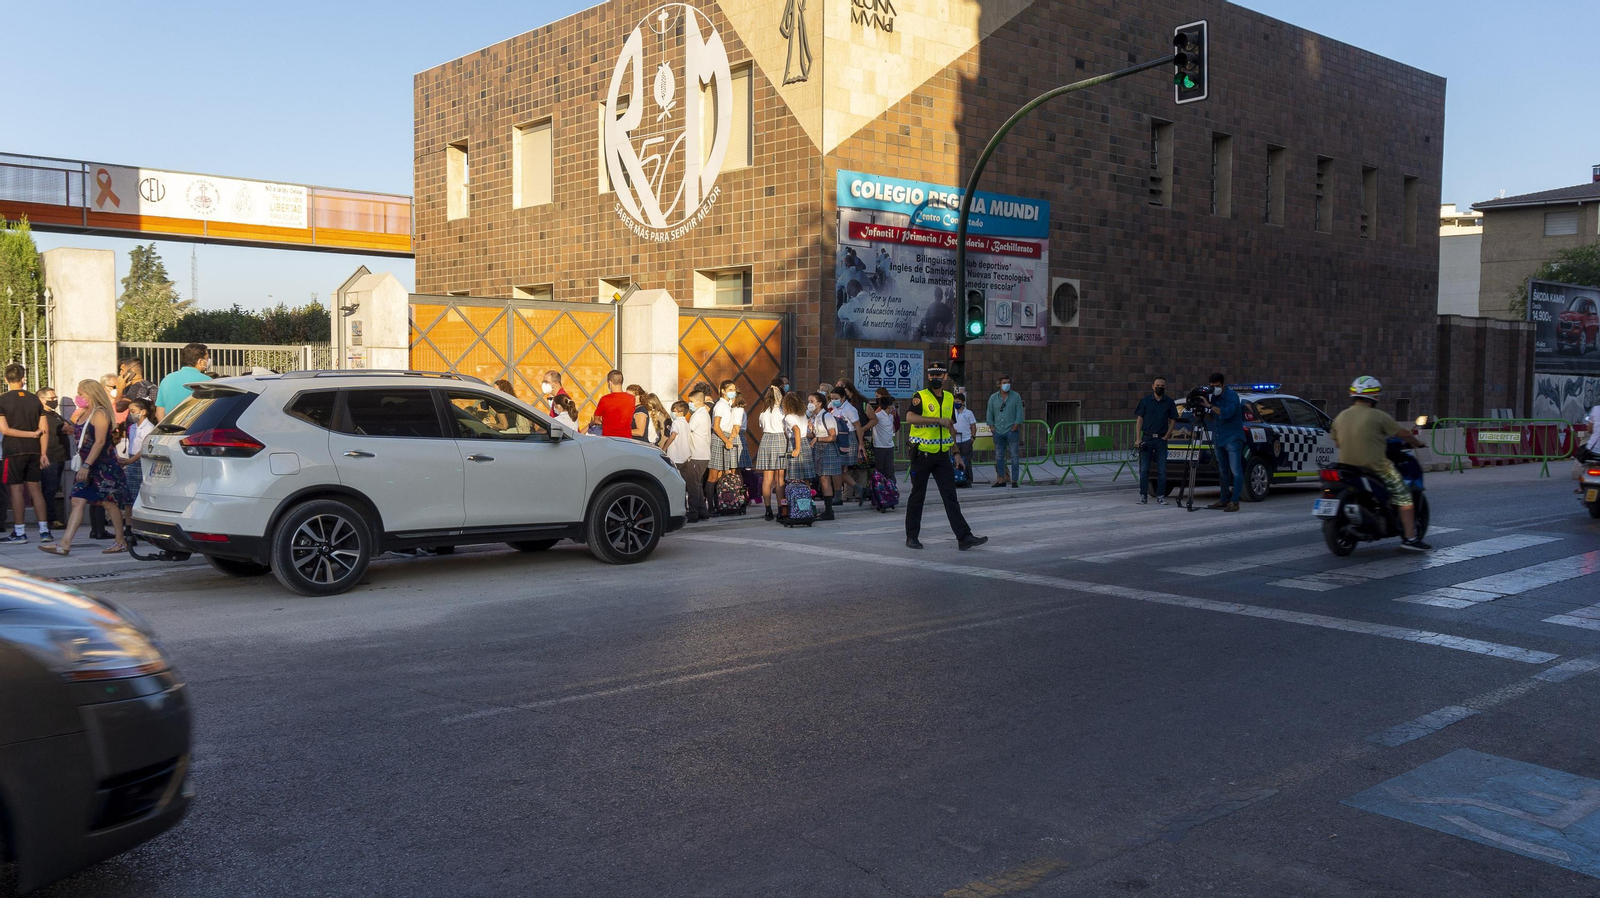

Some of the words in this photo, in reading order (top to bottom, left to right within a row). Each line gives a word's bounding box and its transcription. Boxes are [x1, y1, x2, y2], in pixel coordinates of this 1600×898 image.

[270, 203, 302, 214] LIBERTAD
[851, 180, 924, 205] COLEGIO
[990, 200, 1039, 221] MUNDI
[614, 202, 634, 231] SABER
[633, 226, 649, 240] MÁS
[650, 231, 669, 242] PARA
[671, 217, 698, 240] SERVIR
[697, 185, 722, 223] MEJOR
[914, 211, 941, 223] Centro
[943, 214, 984, 228] Contado
[860, 226, 894, 238] Infantil
[901, 230, 937, 243] Primaria
[991, 241, 1034, 254] Bachillerato
[890, 262, 912, 274] Inglés
[914, 265, 924, 273] de
[925, 266, 957, 278] Cambridg
[967, 270, 992, 278] Nuevas
[909, 275, 926, 284] Aula
[964, 281, 988, 290] omedor
[869, 292, 882, 302] Por
[887, 295, 902, 307] para
[1532, 289, 1549, 302] ŠKODA
[1550, 294, 1566, 304] KAMIQ
[866, 304, 894, 316] educación
[895, 306, 919, 320] integral
[862, 316, 869, 327] de
[870, 320, 894, 328] nuestros
[894, 318, 908, 334] hijos
